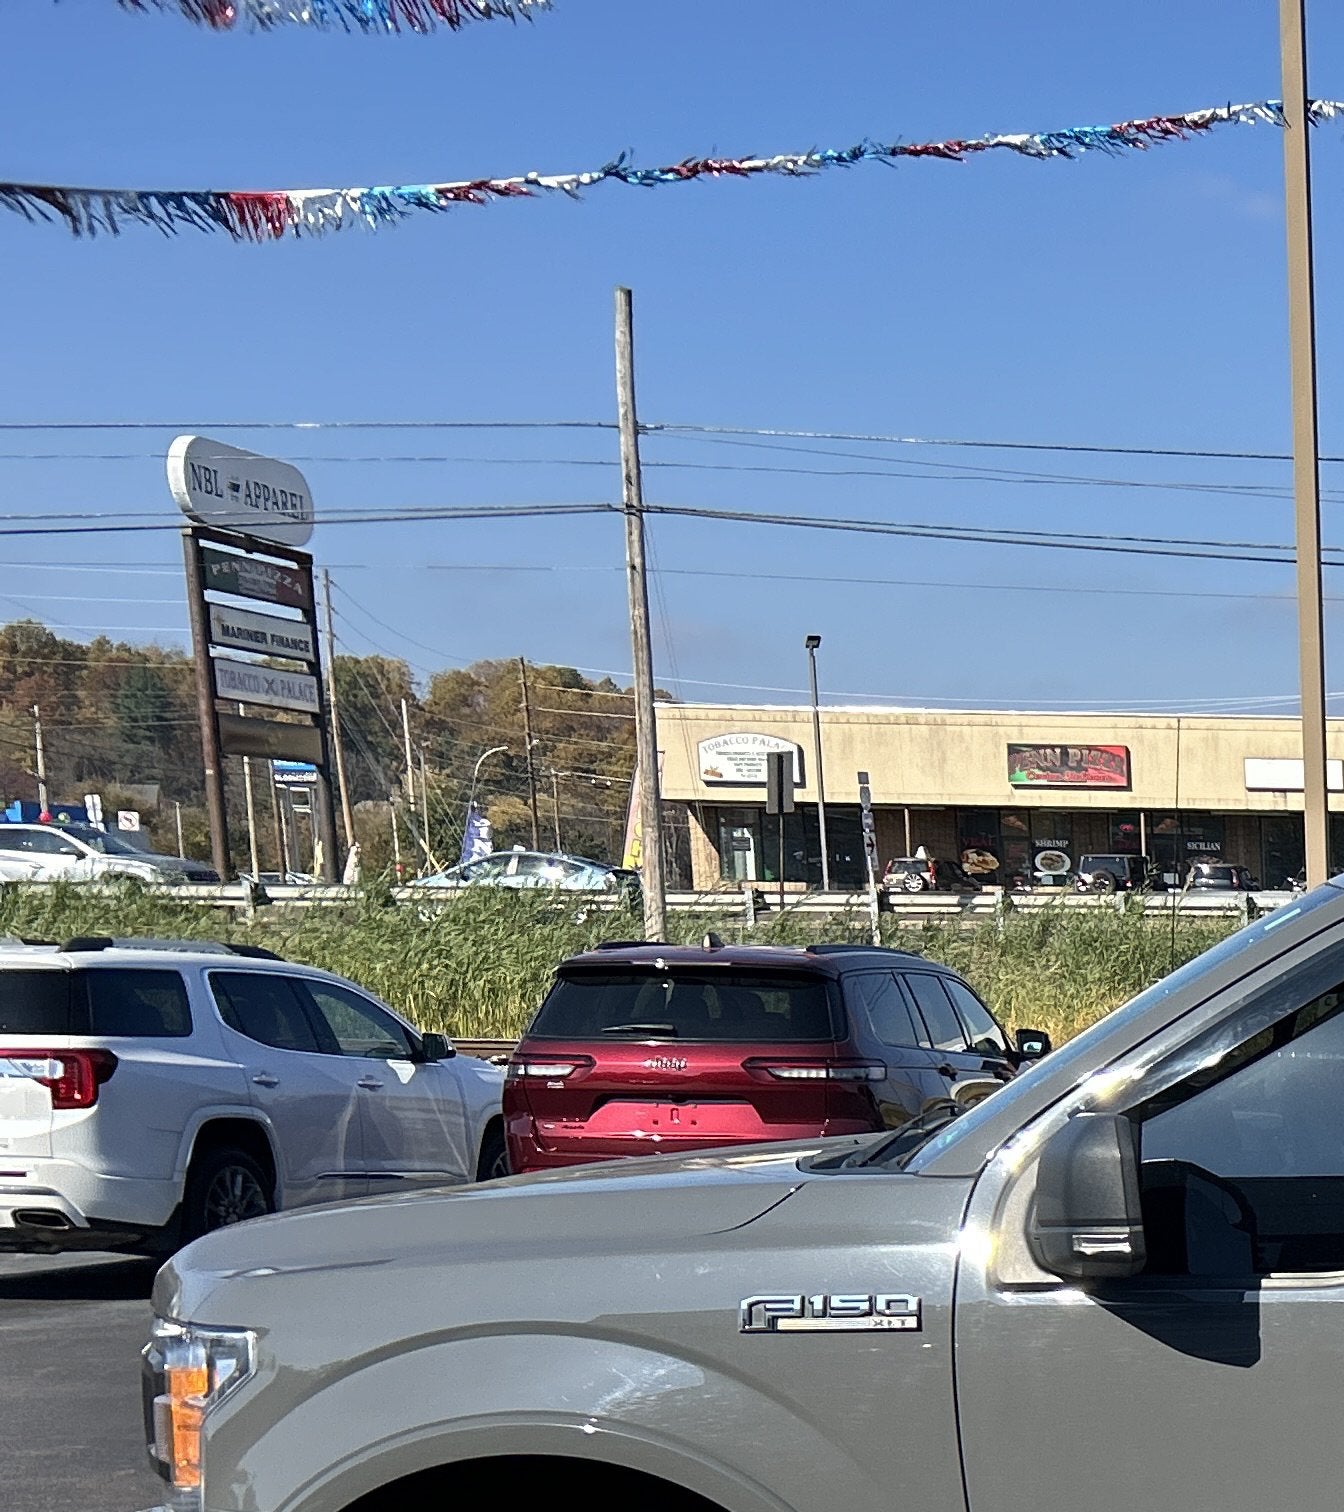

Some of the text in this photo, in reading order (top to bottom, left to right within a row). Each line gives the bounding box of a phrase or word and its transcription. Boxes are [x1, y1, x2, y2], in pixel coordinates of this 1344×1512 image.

[190, 462, 309, 521] NBL APPAREL
[221, 623, 310, 653] MARINER FINANCE
[217, 667, 316, 704] TOBACCO PALACE
[702, 736, 749, 754] TOBACCO
[1034, 839, 1069, 849] SHRIMP
[1186, 841, 1221, 851] SICILIAN
